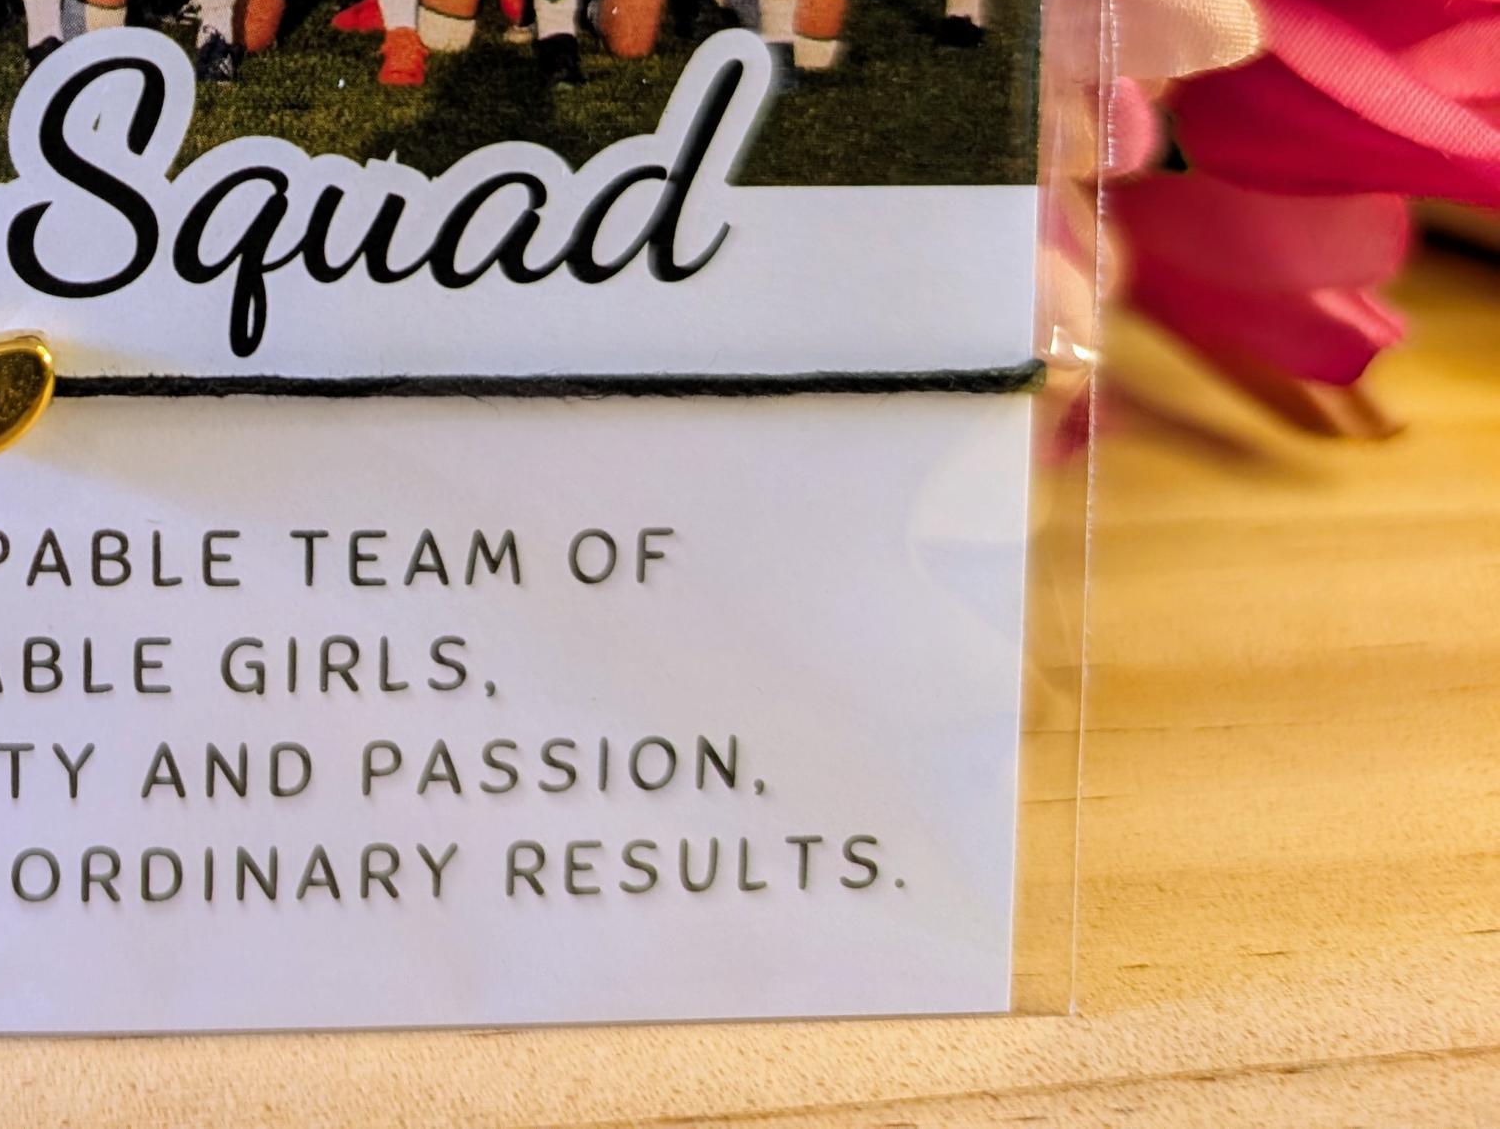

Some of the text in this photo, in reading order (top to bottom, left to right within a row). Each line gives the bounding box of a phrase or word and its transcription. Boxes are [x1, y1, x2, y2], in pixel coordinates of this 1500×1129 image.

[7, 52, 745, 358] Squad
[290, 529, 521, 587] TEAM
[568, 528, 676, 586] OF
[221, 635, 497, 699] GIRLS,
[141, 742, 312, 800] AND
[362, 735, 766, 797] PASSION,
[506, 835, 906, 898] RESULTS.
